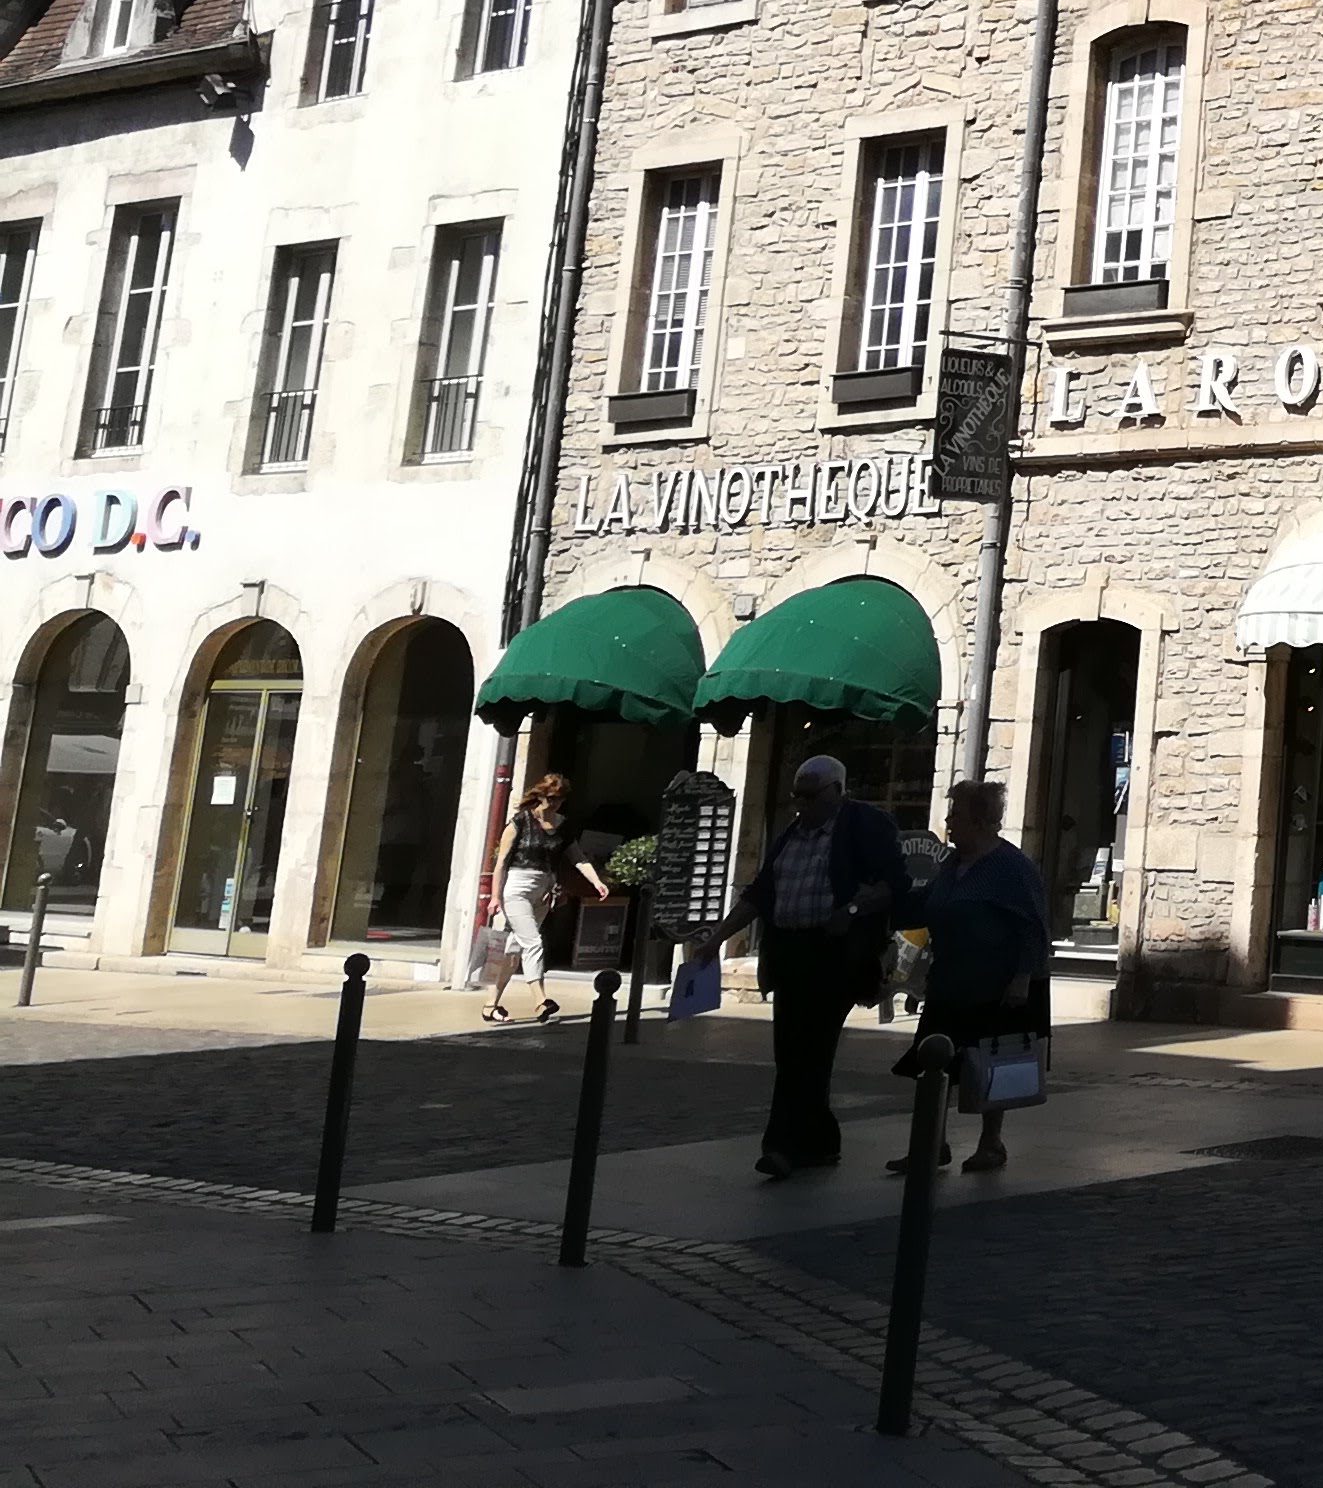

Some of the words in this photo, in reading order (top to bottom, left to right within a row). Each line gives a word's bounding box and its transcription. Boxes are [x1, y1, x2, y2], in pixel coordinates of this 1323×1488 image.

[940, 378, 983, 398] ALCOOLS
[941, 356, 985, 376] LIQUEURS
[932, 453, 956, 477] LA
[946, 367, 1012, 456] VINOTHEQUE
[575, 472, 632, 532] LA
[652, 454, 941, 529] VINOTHEQUE
[0, 496, 77, 560] CO
[901, 837, 951, 864] OTHEQU
